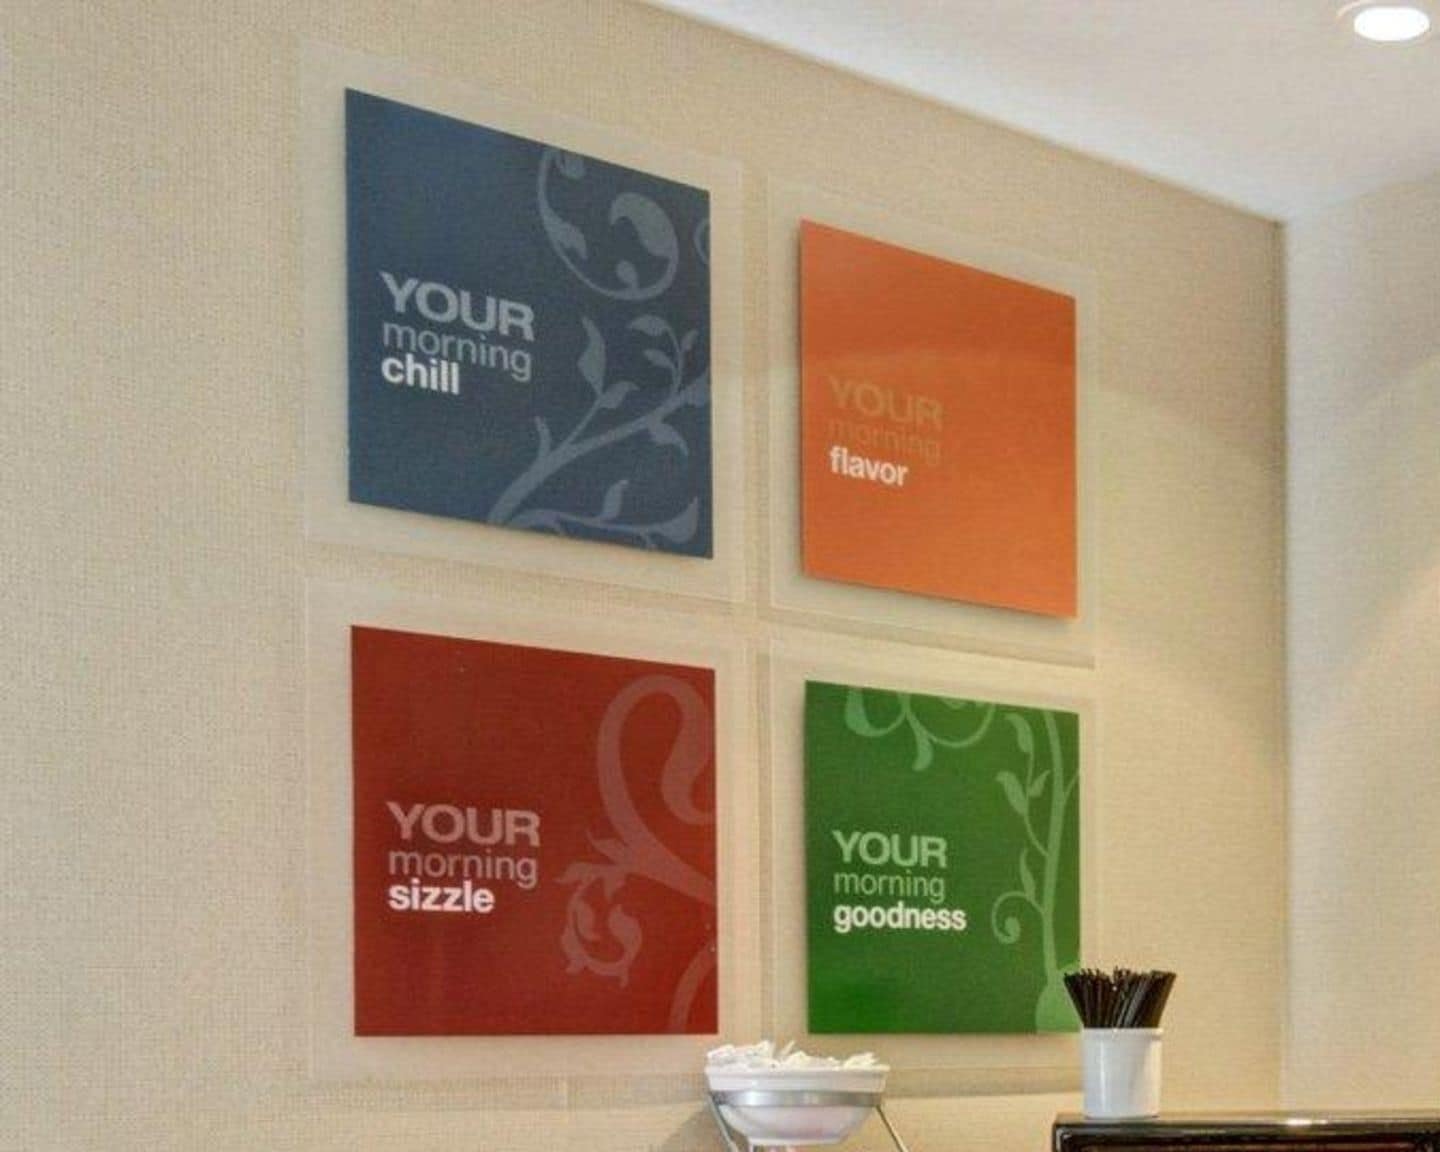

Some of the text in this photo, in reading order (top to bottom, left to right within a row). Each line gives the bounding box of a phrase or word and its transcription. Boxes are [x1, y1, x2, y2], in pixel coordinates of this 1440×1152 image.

[379, 271, 534, 341] YOUR
[383, 322, 531, 382] morning
[381, 353, 460, 395] chill
[828, 376, 943, 431] YOUR
[830, 445, 909, 486] flavor
[386, 801, 541, 846] YOUR
[389, 849, 538, 889] morning
[832, 830, 948, 868] YOUR
[388, 877, 495, 914] sizzle
[834, 869, 945, 904] morning
[833, 901, 967, 933] goodness
